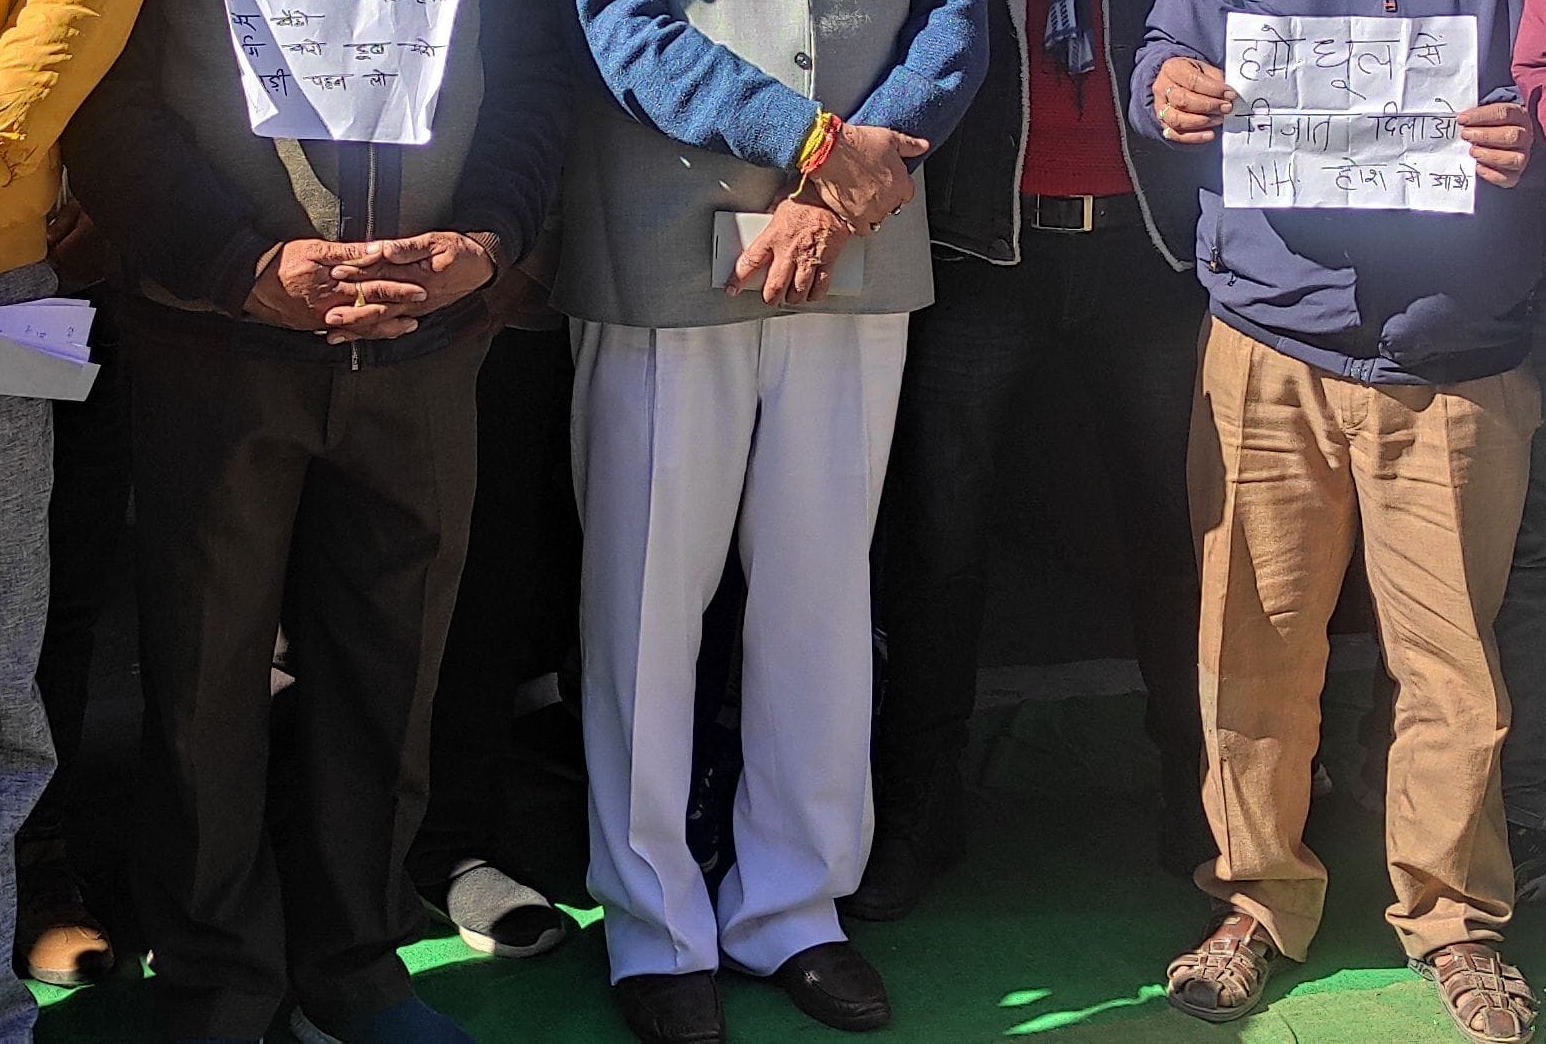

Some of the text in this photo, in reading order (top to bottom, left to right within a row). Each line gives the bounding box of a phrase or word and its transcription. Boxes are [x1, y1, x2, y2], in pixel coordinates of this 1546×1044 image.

[363, 71, 398, 88] लो
[1312, 38, 1401, 101] धूल
[1234, 96, 1460, 151] निजात दिलाओ
